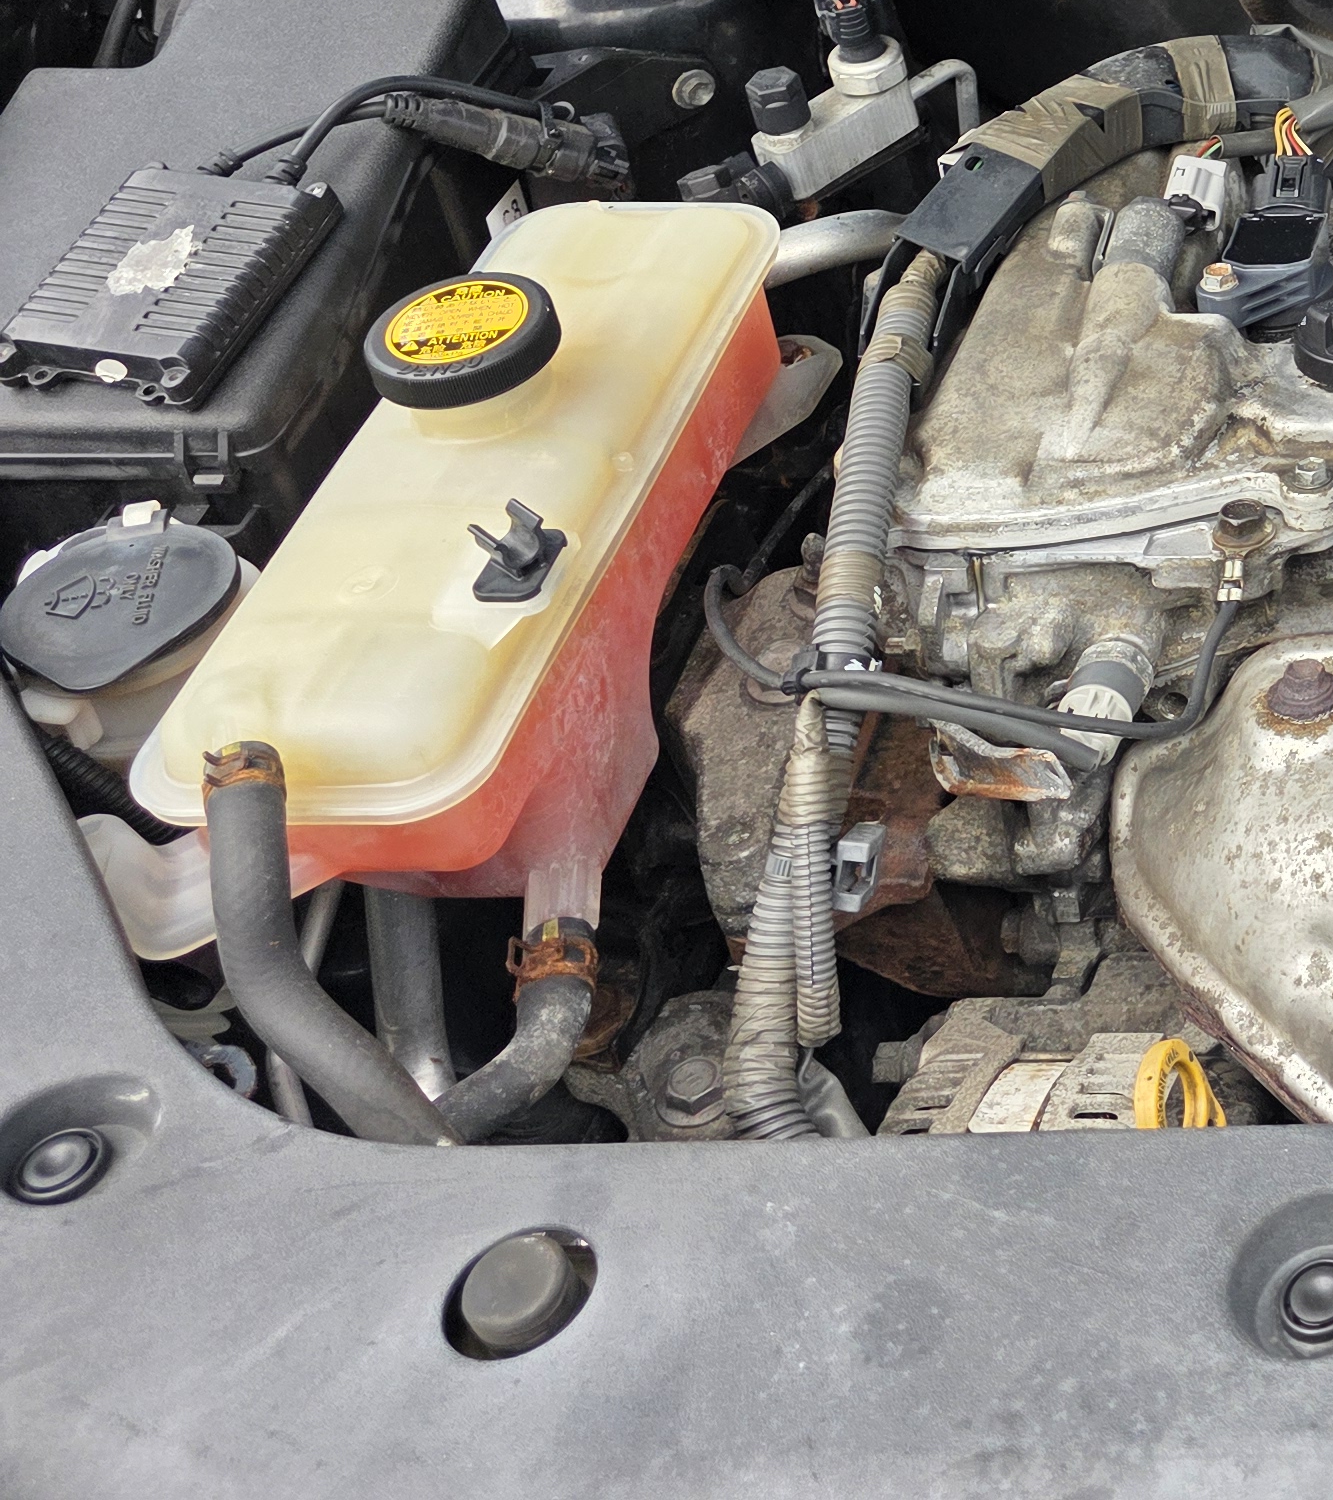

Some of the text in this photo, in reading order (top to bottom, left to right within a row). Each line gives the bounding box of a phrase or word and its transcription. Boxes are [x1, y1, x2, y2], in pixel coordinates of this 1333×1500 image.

[441, 289, 506, 303] CAUTION
[427, 330, 499, 346] ATTENTION
[397, 355, 485, 377] DENSO
[120, 572, 141, 600] ONLY
[132, 546, 170, 625] WASHER FLUID
